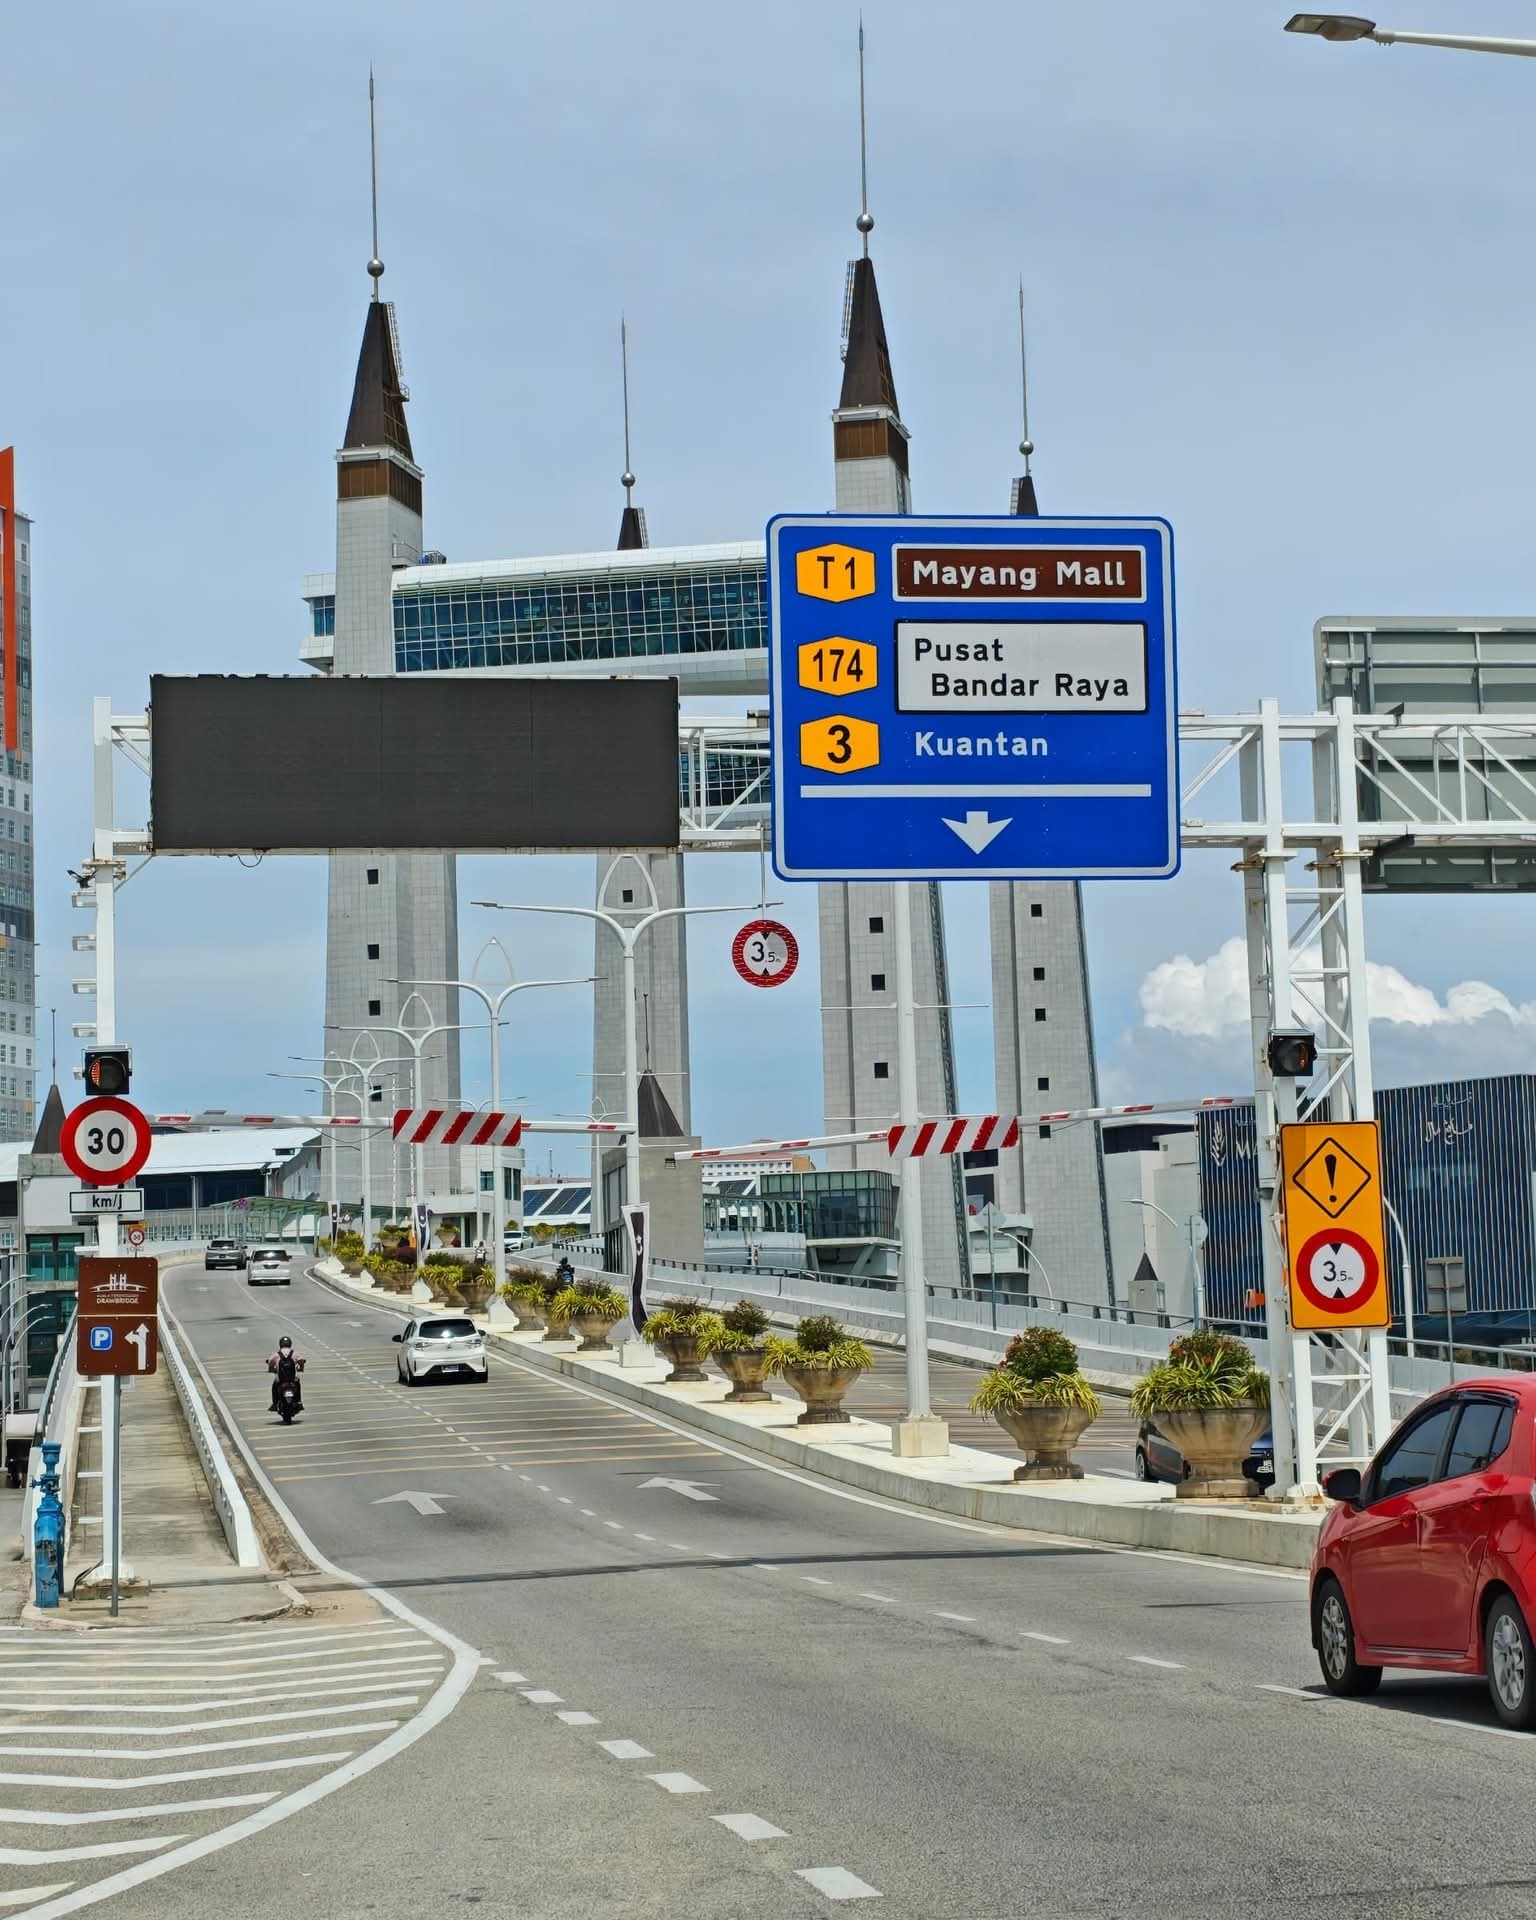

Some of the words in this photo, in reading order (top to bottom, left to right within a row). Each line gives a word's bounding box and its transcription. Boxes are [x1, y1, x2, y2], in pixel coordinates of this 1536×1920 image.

[816, 556, 856, 590] T1
[912, 560, 1037, 591] Mayang
[1056, 561, 1126, 586] Mall
[914, 638, 1004, 662] Pusat
[812, 648, 864, 683] 174
[931, 673, 1040, 697] Bandar
[1055, 673, 1129, 702] Raya
[827, 724, 852, 764] 3
[915, 731, 1048, 757] Kuantan
[87, 1127, 125, 1155] 30
[92, 1194, 123, 1211] km/j
